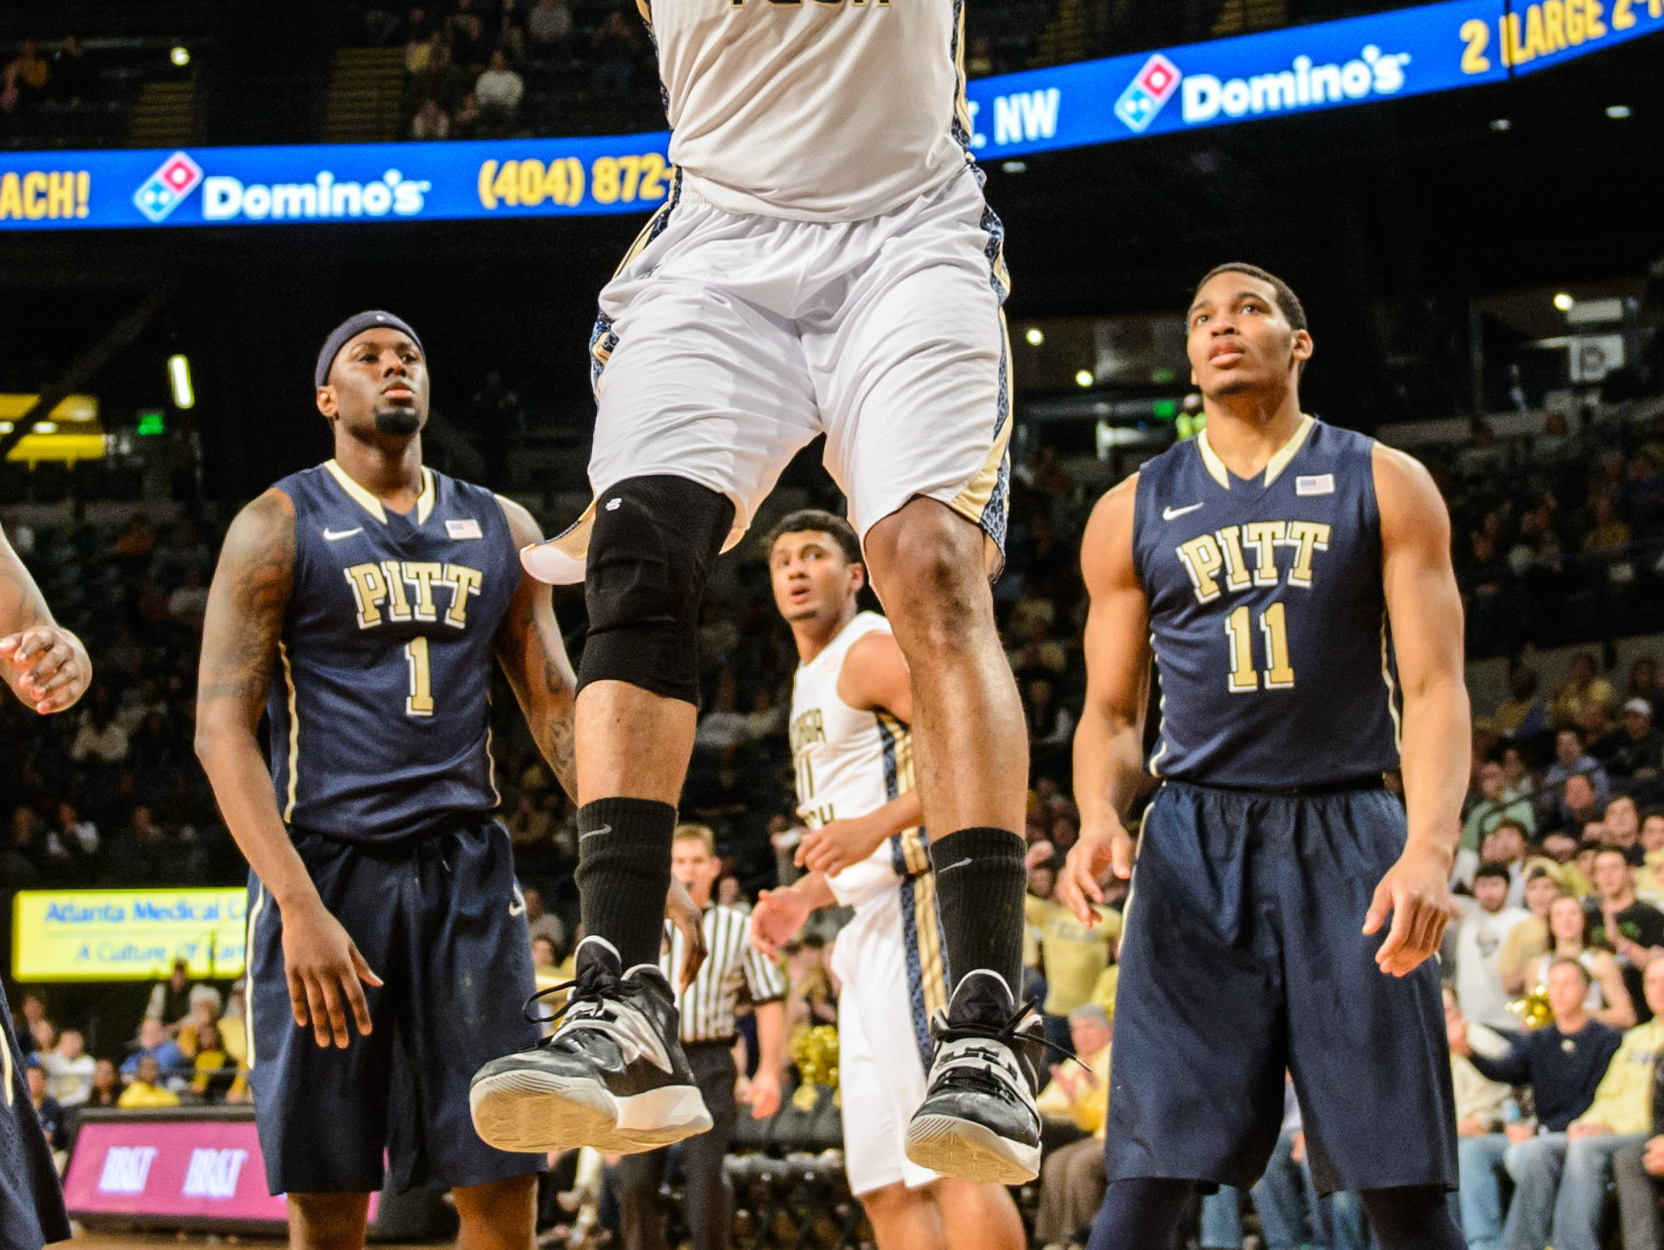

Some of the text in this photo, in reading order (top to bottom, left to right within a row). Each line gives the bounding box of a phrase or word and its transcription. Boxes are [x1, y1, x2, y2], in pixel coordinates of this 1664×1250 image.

[1459, 18, 1491, 75] 2
[993, 87, 1061, 146] NW
[1180, 44, 1412, 124] Domino's
[202, 168, 432, 222] Domino's
[478, 157, 585, 210] (404)
[343, 559, 484, 630] PITT
[1175, 520, 1332, 605] PITT
[404, 635, 434, 717] 1
[1224, 602, 1295, 693] 11
[44, 900, 125, 923] Atlanta
[133, 898, 220, 922] Medical
